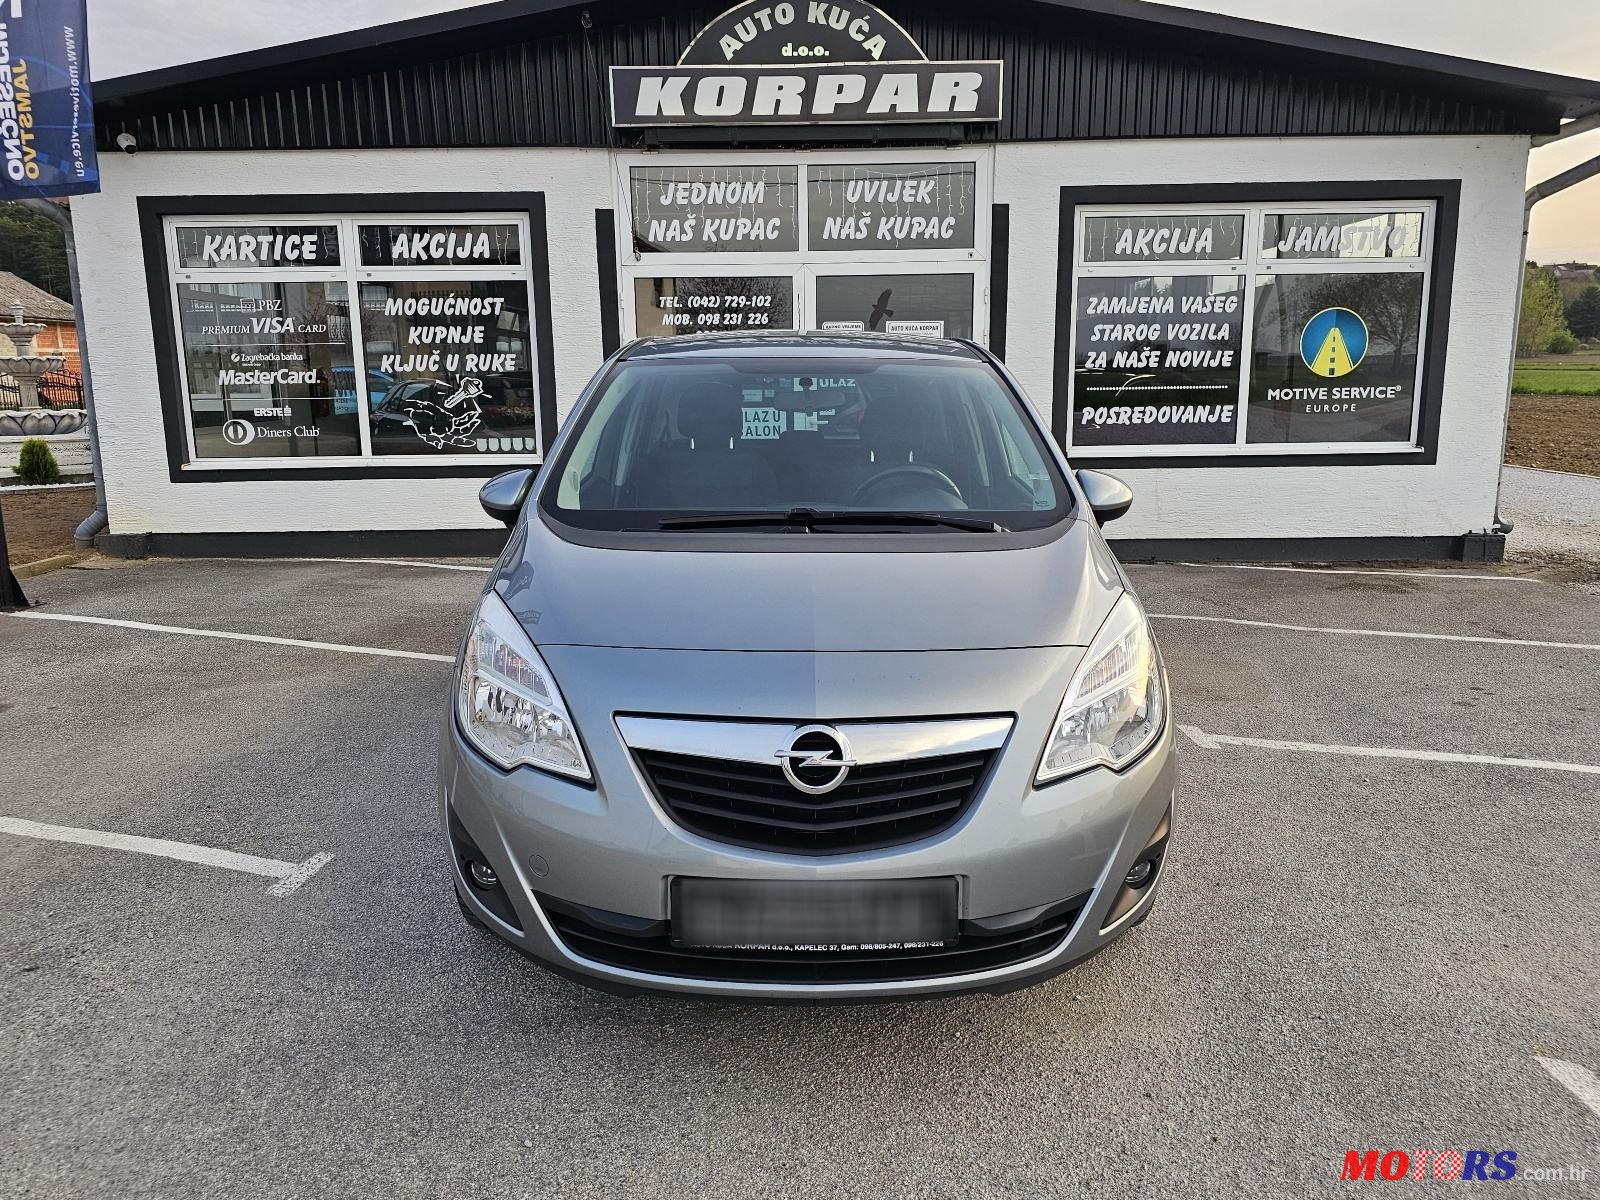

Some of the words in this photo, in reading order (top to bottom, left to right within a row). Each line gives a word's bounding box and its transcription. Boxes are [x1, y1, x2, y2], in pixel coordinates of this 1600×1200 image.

[719, 2, 795, 61] AUTO
[808, 2, 887, 61] KUĆA
[781, 42, 830, 57] d.o.o.
[635, 72, 983, 117] KORPAR
[660, 181, 765, 205] JEDNOM
[846, 180, 934, 204] UVIJEK
[648, 213, 696, 242] NAŠ
[702, 217, 780, 242] KUPAC
[823, 212, 871, 240] NAŠ
[877, 216, 955, 240] KUPAC
[202, 234, 318, 263] KARTICE
[392, 233, 490, 260] AKCIJA
[1114, 226, 1213, 256] AKCIJA
[1278, 225, 1408, 254] JAMSTVO
[258, 300, 282, 311] PBZ
[384, 293, 505, 316] MOGUĆNOST
[659, 296, 682, 308] TEL.
[687, 296, 720, 308] (042)
[724, 295, 772, 307] 729-102
[1086, 297, 1174, 314] ZAMJENA
[1181, 291, 1238, 314] VAŠEG
[201, 325, 250, 335] PREMIUM
[250, 317, 295, 334] VISA
[298, 324, 327, 333] CARD
[662, 313, 693, 325] MOB.
[698, 313, 720, 325] 098
[723, 313, 742, 325] 231
[748, 313, 769, 325] 226
[408, 326, 485, 345] KUPNJE
[1091, 323, 1161, 342] STAROG
[1167, 323, 1230, 341] VOZILA
[281, 352, 303, 361] banka
[380, 350, 440, 373] KLJUČ
[446, 354, 459, 372] U
[465, 354, 516, 372] RUKE
[1085, 351, 1107, 368] ZA
[1112, 346, 1161, 368] NAŠE
[1165, 350, 1234, 368] NOVIJE
[819, 378, 856, 388] ULAZ
[1267, 388, 1328, 401] MOTIVE
[253, 407, 283, 417] ERSTE
[744, 410, 770, 423] LAZ
[1081, 405, 1234, 425] POSREDOVANJE
[1305, 403, 1357, 413] EUROPE
[257, 426, 292, 438] Diners
[745, 425, 781, 437] ALON
